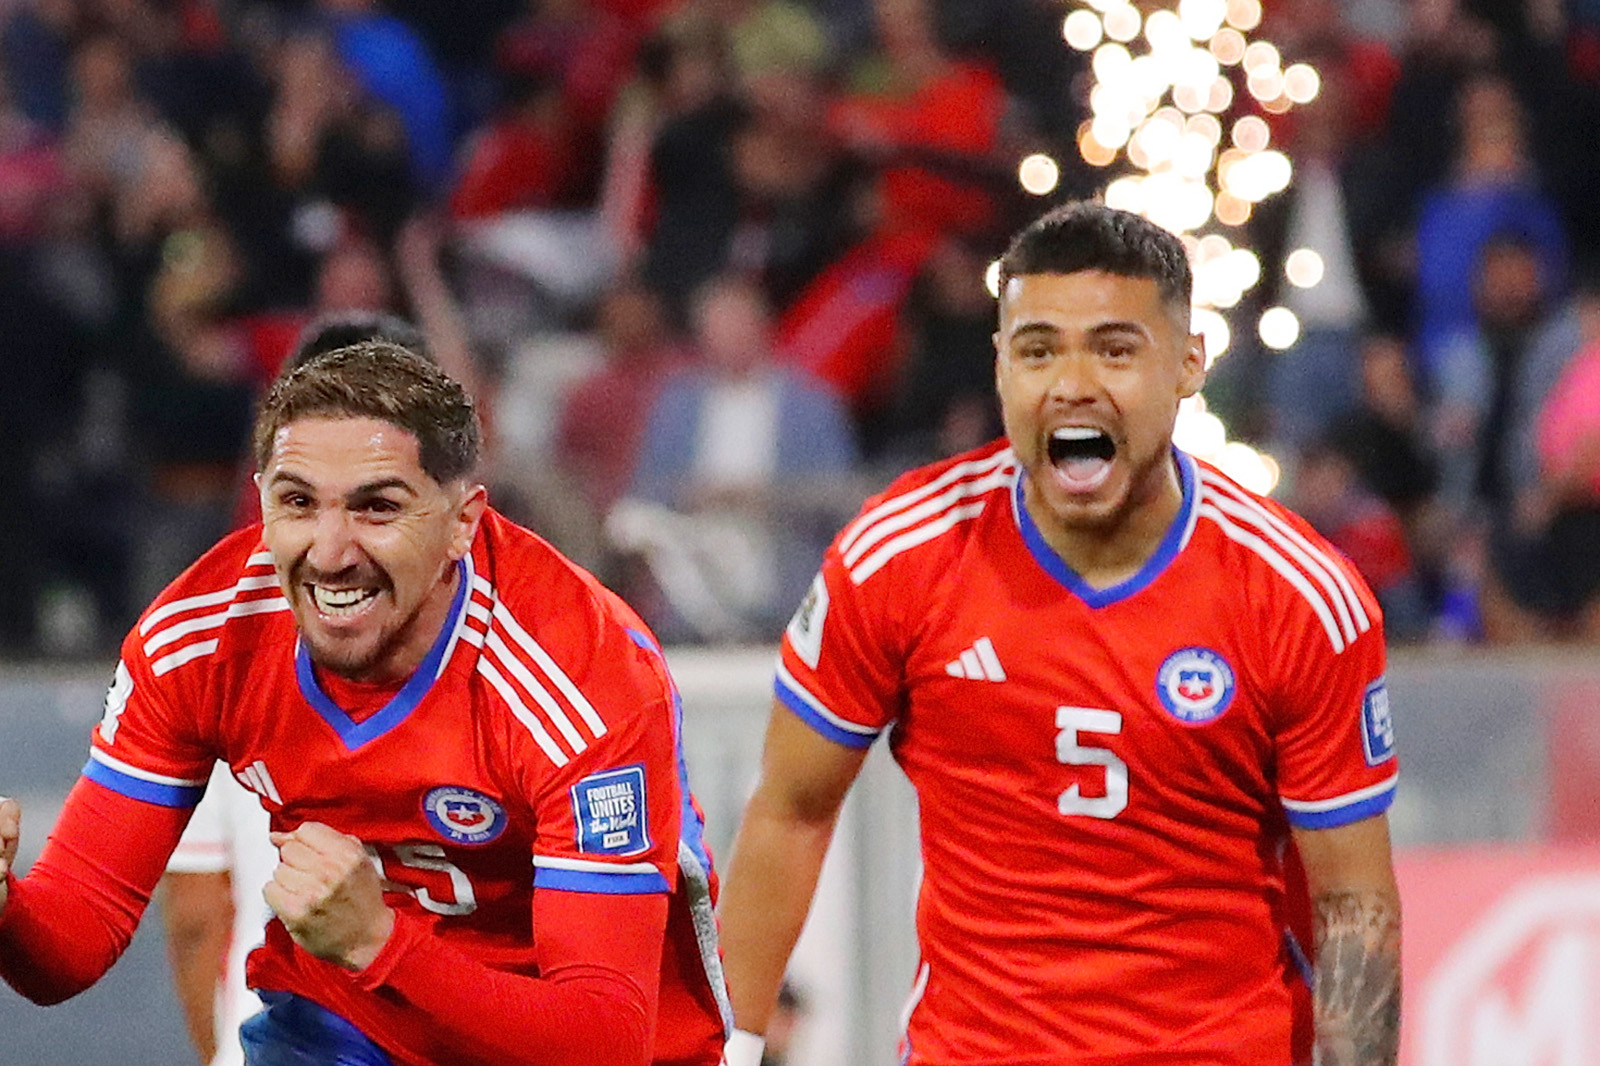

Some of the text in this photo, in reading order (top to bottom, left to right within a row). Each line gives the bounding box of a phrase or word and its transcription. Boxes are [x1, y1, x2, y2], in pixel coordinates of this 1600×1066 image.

[1055, 705, 1129, 819] 5
[587, 782, 634, 802] FOOTBALL
[589, 795, 636, 818] UNITES
[589, 811, 638, 834] the World
